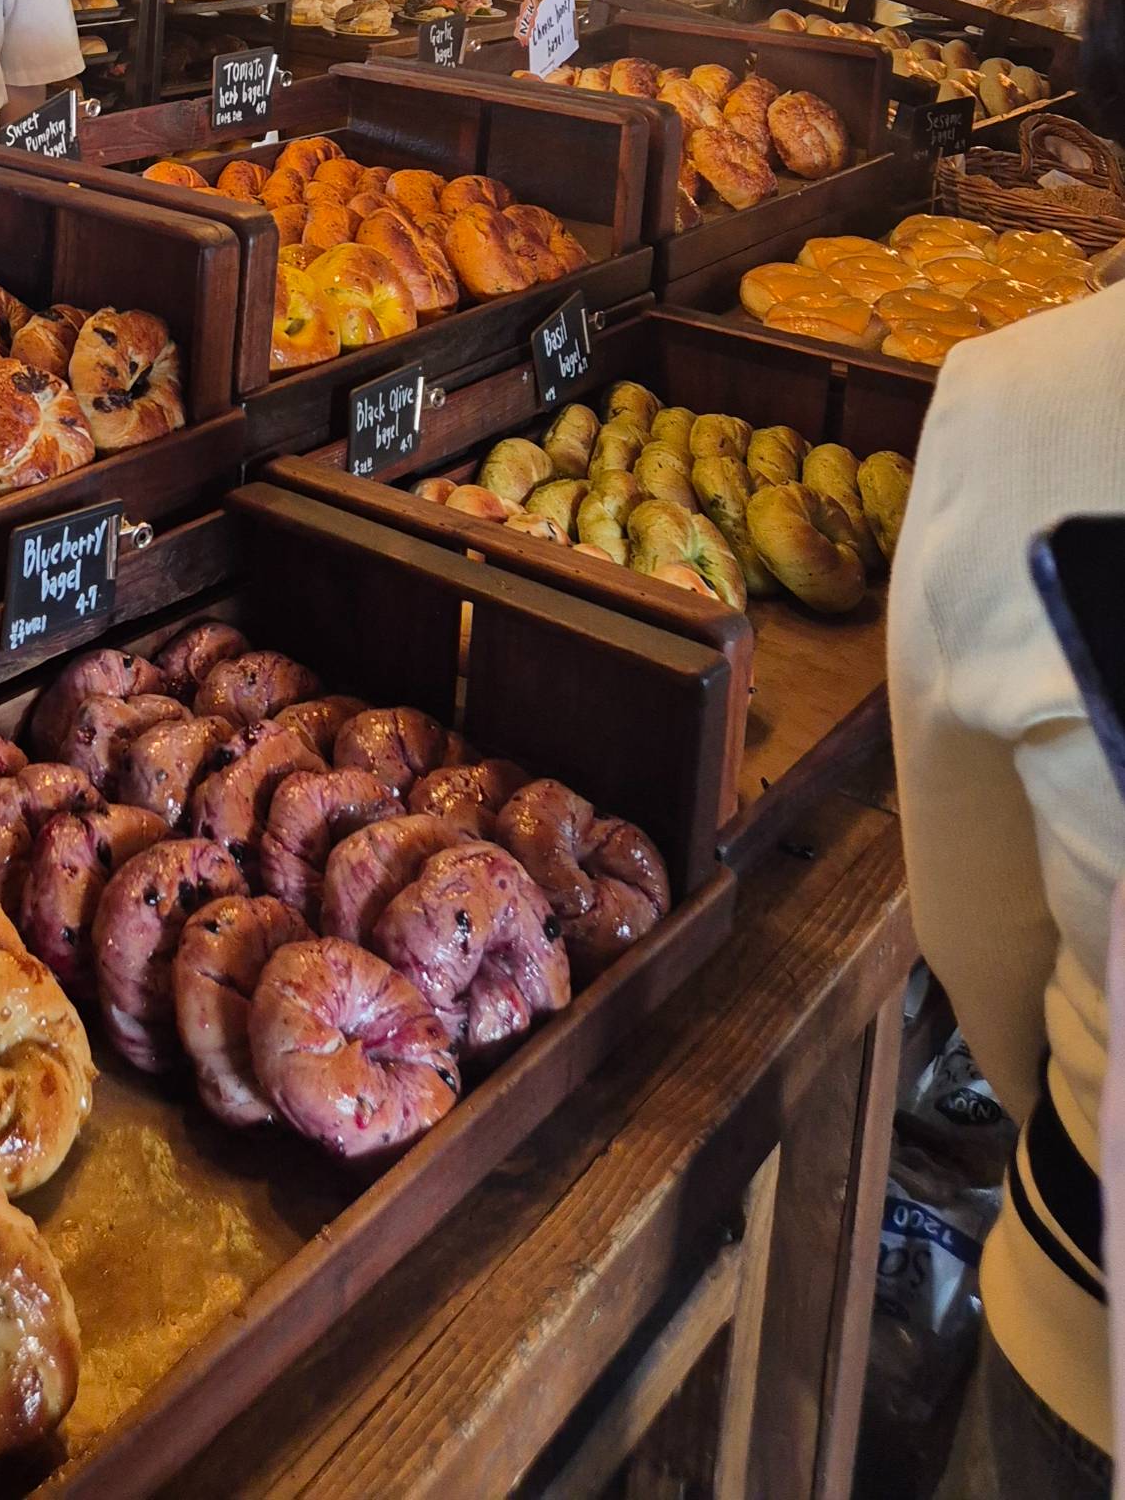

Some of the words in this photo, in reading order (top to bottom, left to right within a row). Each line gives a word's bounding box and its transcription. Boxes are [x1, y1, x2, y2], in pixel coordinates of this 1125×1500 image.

[430, 20, 453, 46] Garlic
[435, 42, 453, 67] bagel
[219, 85, 239, 109] herb
[242, 79, 265, 106] bagel
[6, 112, 40, 147] Sweet
[543, 311, 568, 357] Basil
[558, 338, 581, 378] bagel
[356, 392, 386, 432] Black
[389, 384, 415, 413] Olive
[376, 412, 400, 451] bagel
[23, 519, 107, 579] Blueberry
[41, 559, 82, 602] bagel
[75, 584, 98, 616] 4.7
